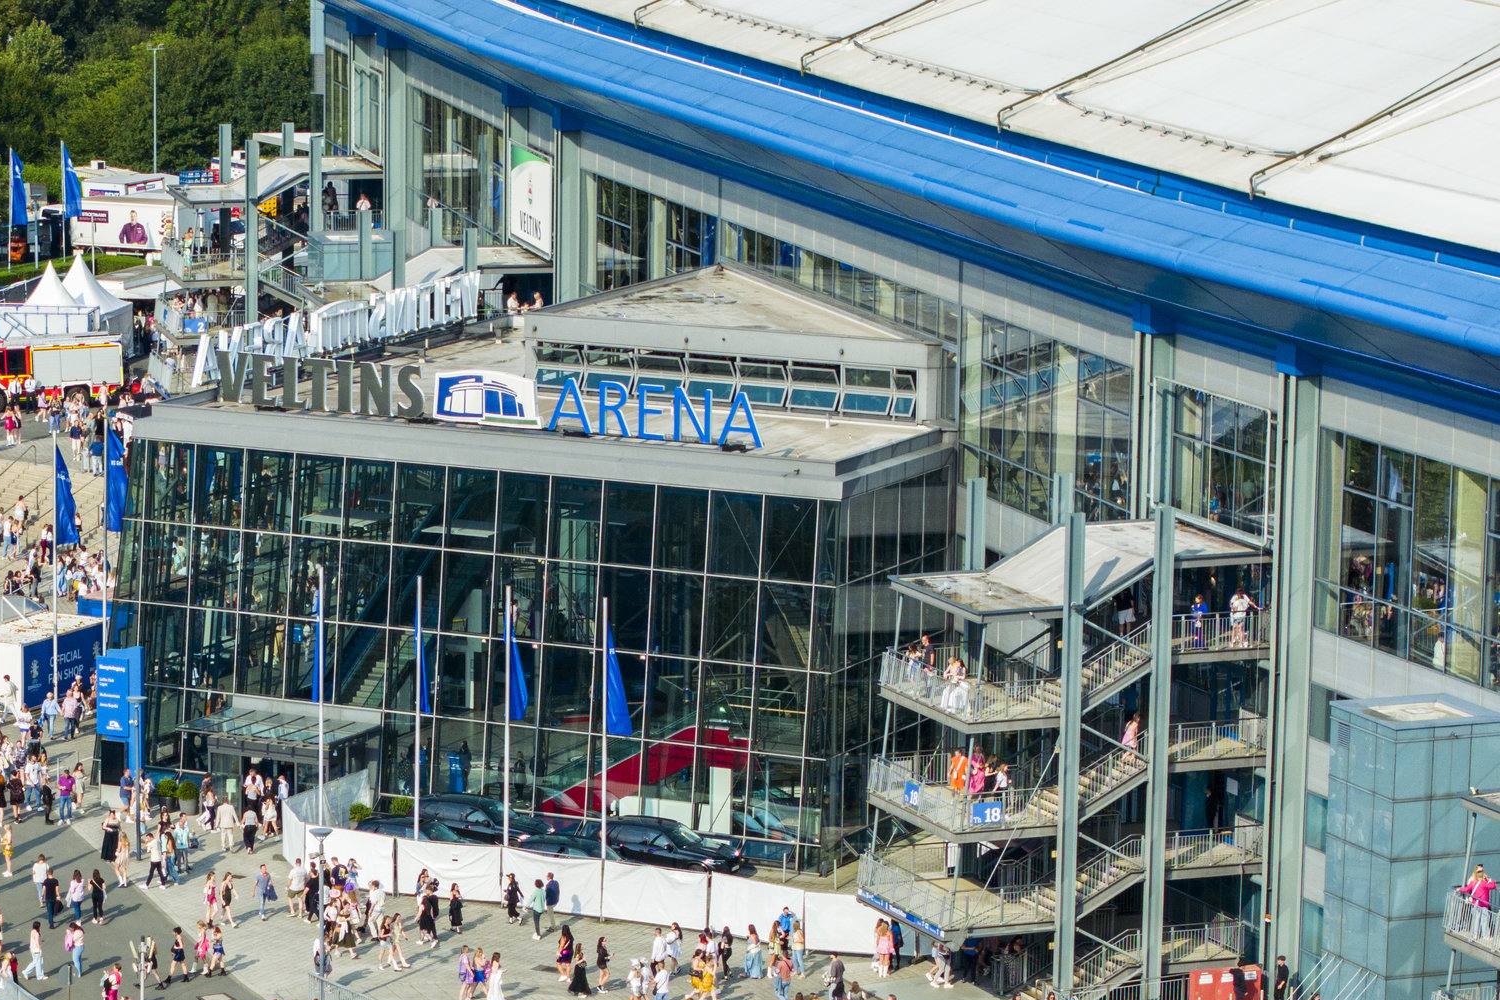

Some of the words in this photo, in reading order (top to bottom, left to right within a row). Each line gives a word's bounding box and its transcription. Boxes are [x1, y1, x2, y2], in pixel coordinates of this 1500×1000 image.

[520, 209, 541, 241] VELTINS
[197, 322, 205, 332] 2
[217, 350, 425, 418] VELTINS
[547, 377, 765, 448] ARENA
[48, 672, 63, 684] FN
[64, 664, 84, 680] SHOP
[910, 789, 918, 806] 18
[984, 807, 1001, 823] 18
